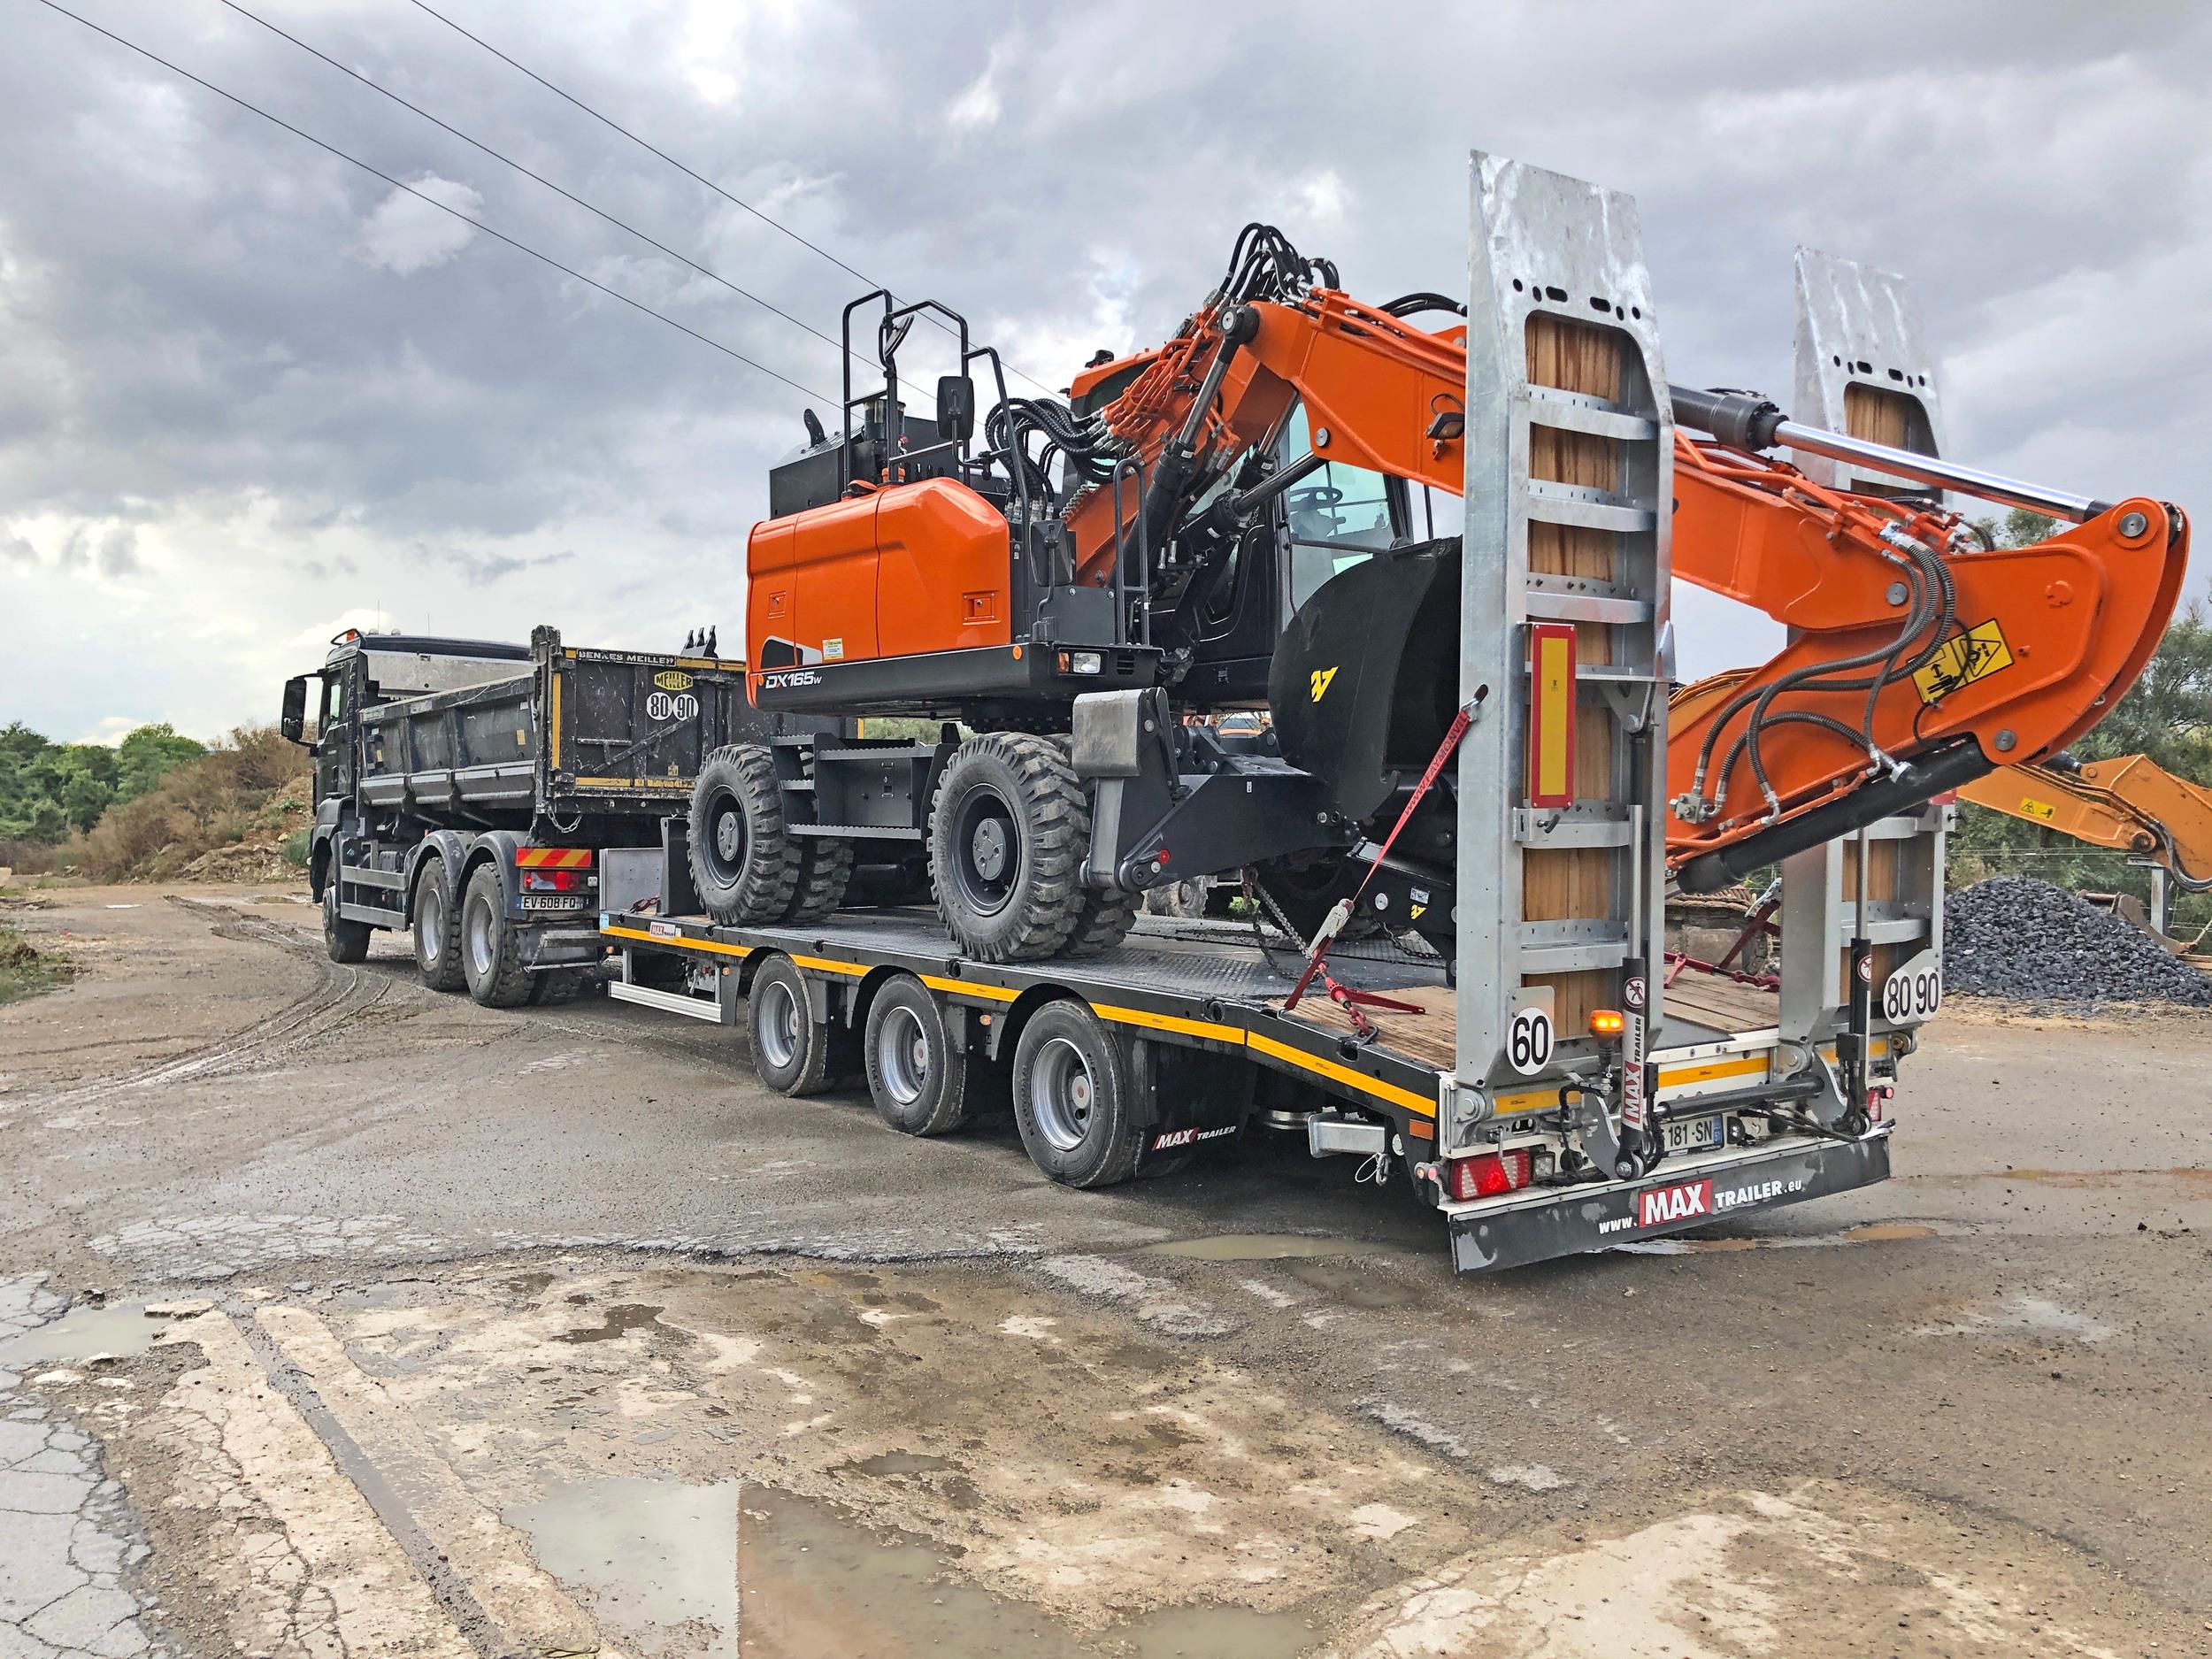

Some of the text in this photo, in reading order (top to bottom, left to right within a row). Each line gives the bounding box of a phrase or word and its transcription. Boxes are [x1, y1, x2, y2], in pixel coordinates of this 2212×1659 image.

[656, 672, 692, 688] MEILLER
[650, 695, 695, 718] 80 90
[1887, 972, 1939, 1018] 80 90
[1512, 1015, 1548, 1067] 60
[1624, 1069, 1640, 1118] MAX
[1156, 1125, 1236, 1149] MAX TRAILER
